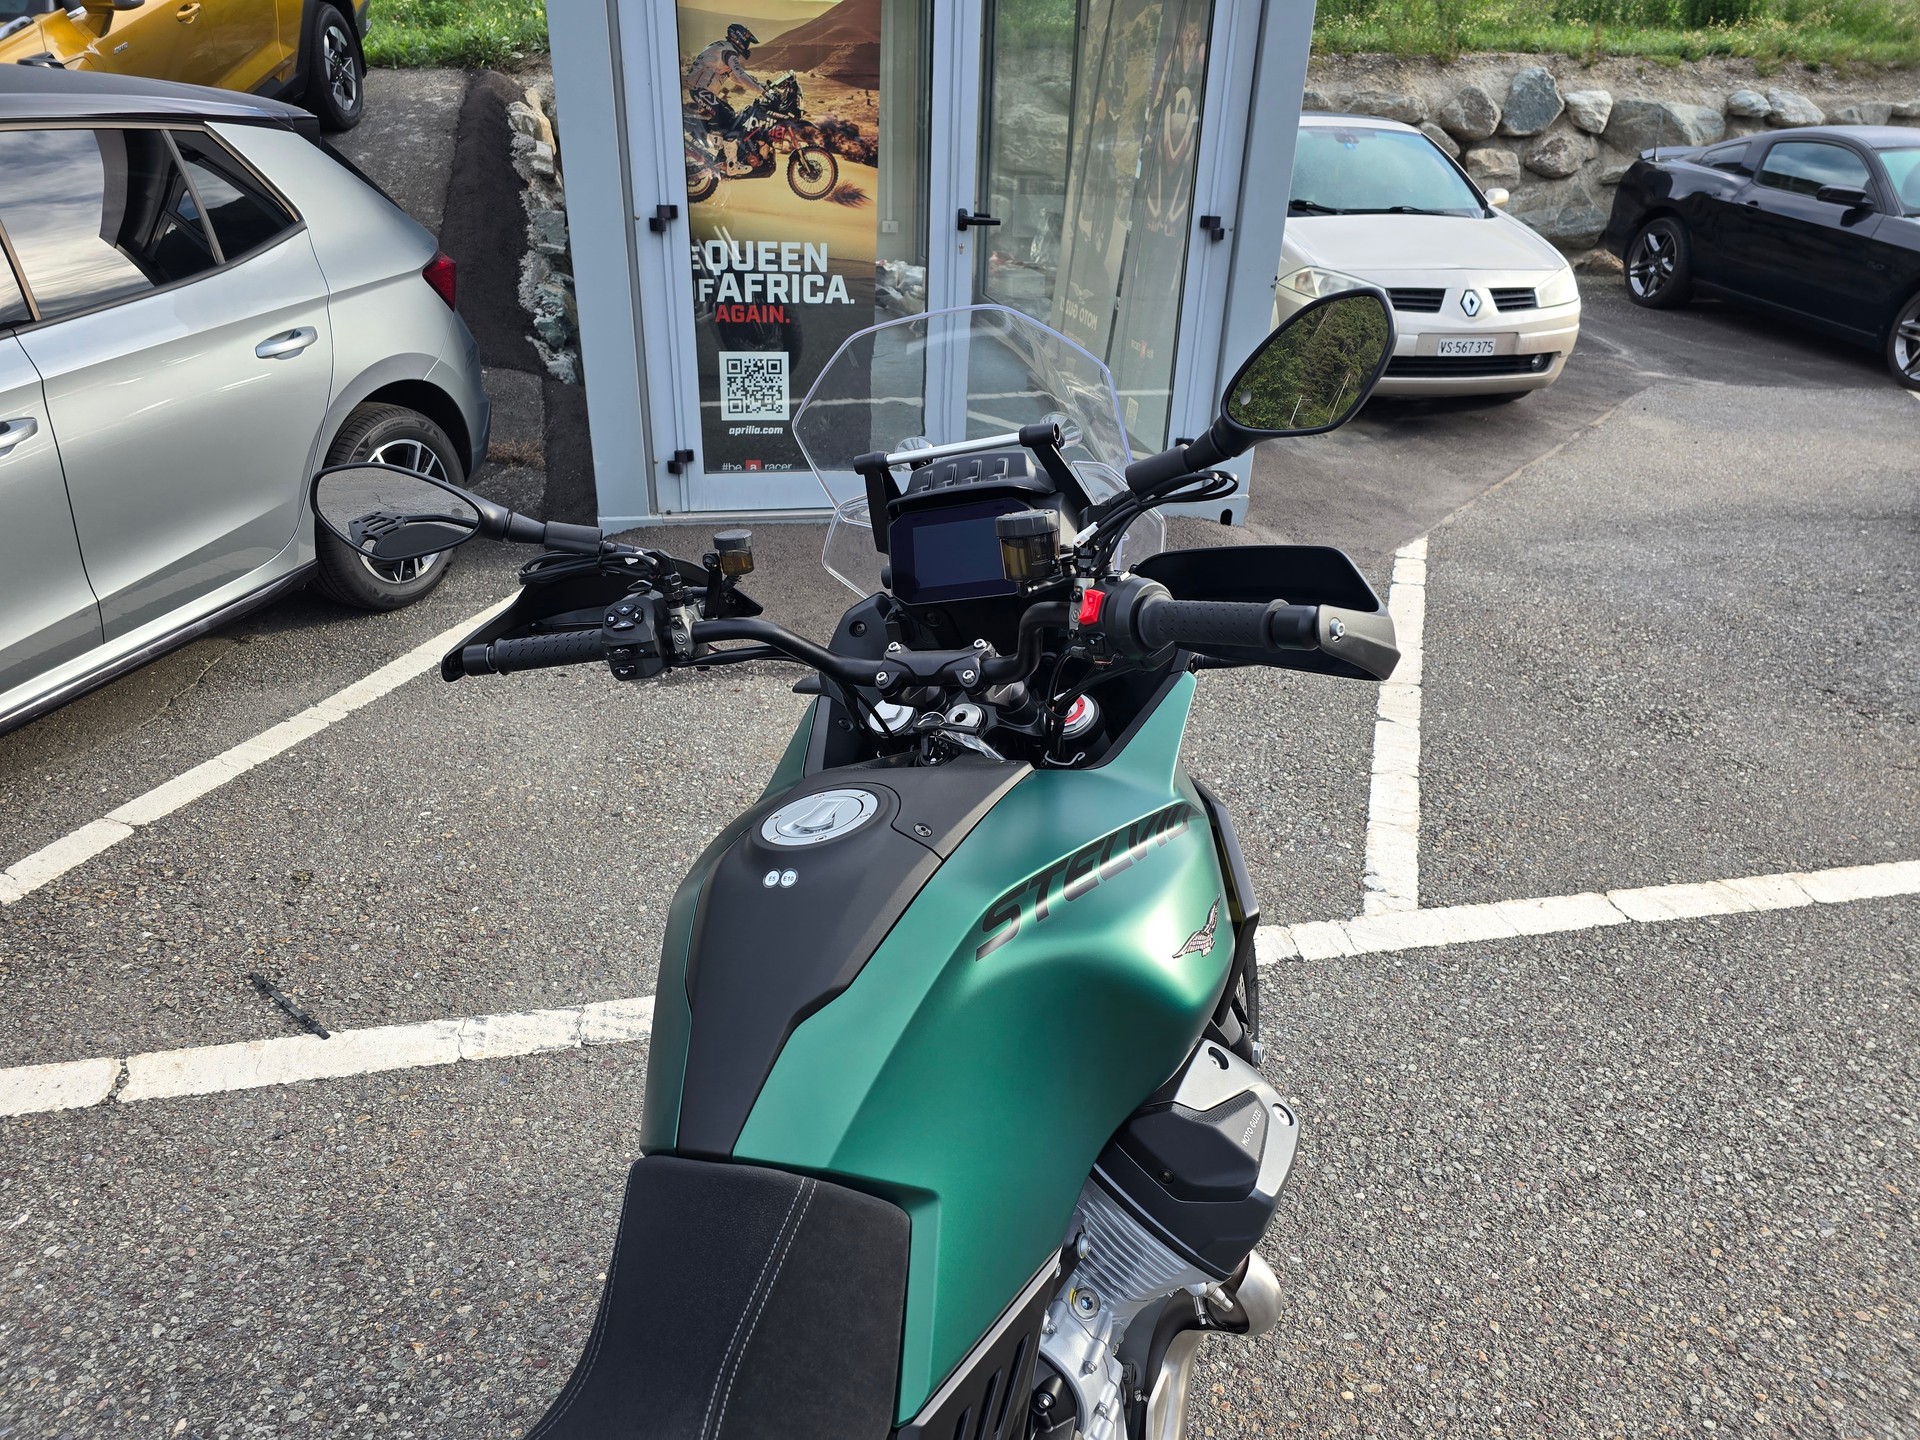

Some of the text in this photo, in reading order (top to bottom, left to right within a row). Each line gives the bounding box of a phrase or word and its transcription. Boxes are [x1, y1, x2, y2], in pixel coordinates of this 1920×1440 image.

[704, 239, 828, 275] QUEEN
[693, 272, 856, 304] F AFRICA.
[715, 304, 791, 324] AGAIN.
[728, 424, 784, 436] aprilia.com
[722, 462, 742, 471] #be
[764, 462, 792, 471] racer
[975, 802, 1191, 962] STELVIO
[1241, 1109, 1261, 1146] MOTO GUZZI
